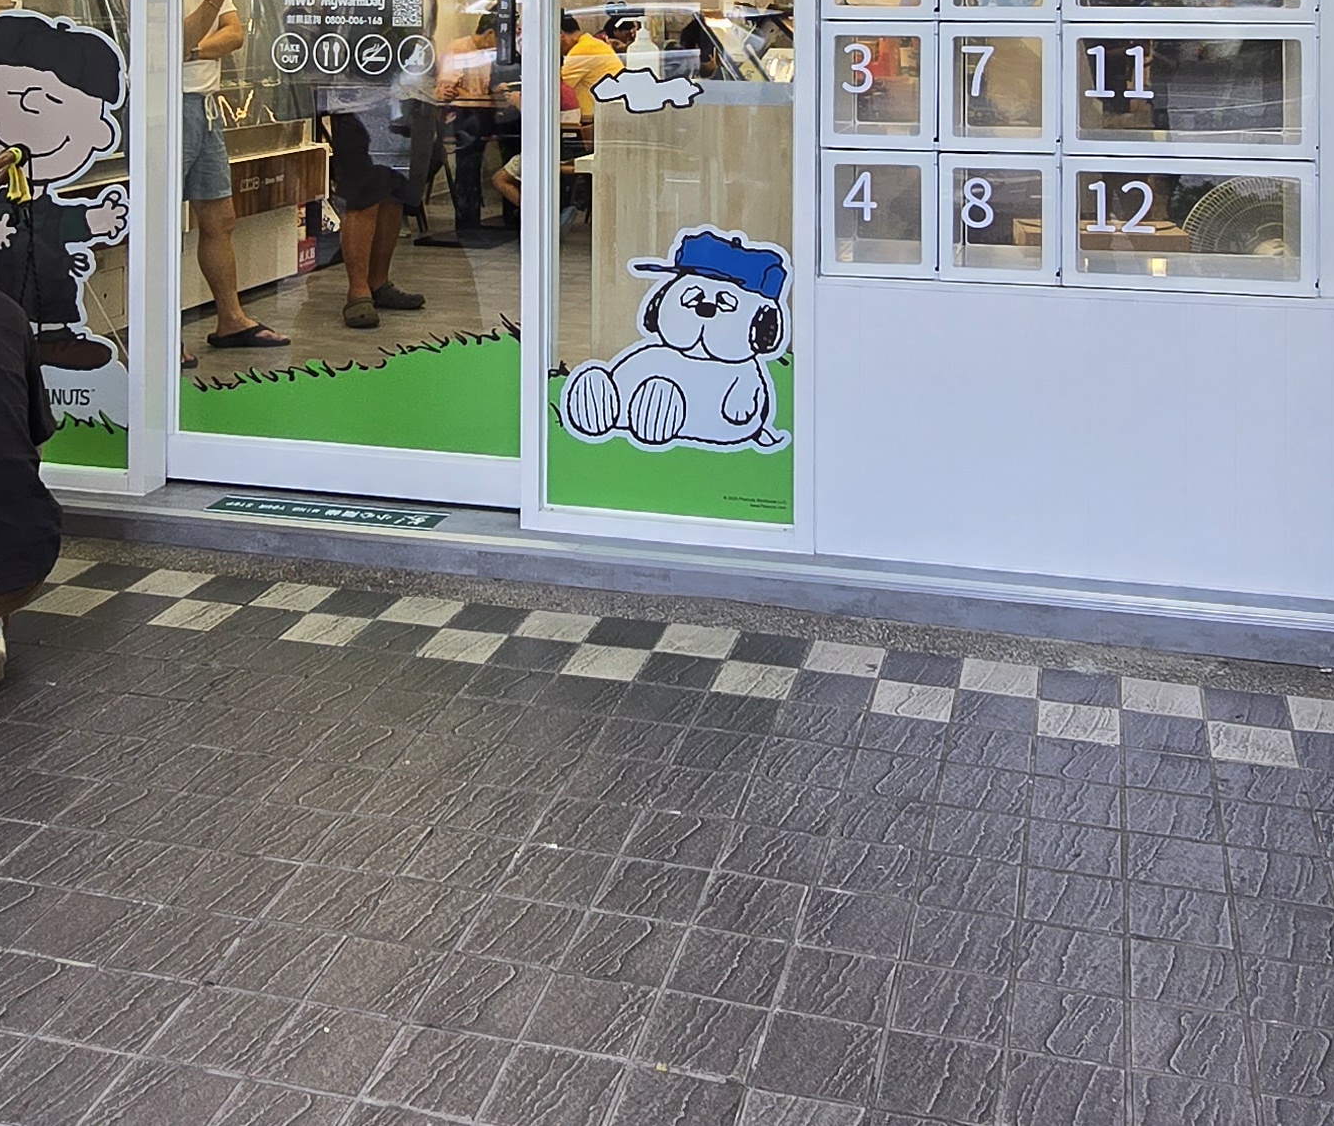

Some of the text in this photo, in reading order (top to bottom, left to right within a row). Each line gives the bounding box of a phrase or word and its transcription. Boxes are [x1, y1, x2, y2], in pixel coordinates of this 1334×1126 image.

[279, 43, 300, 52] TAKE
[281, 54, 299, 63] OUT
[842, 44, 873, 93] 3
[962, 46, 994, 96] 7
[1084, 45, 1154, 98] 11
[843, 171, 877, 221] 4
[961, 177, 994, 228] 8
[1086, 180, 1155, 233] 12
[46, 388, 90, 405] NUTS
